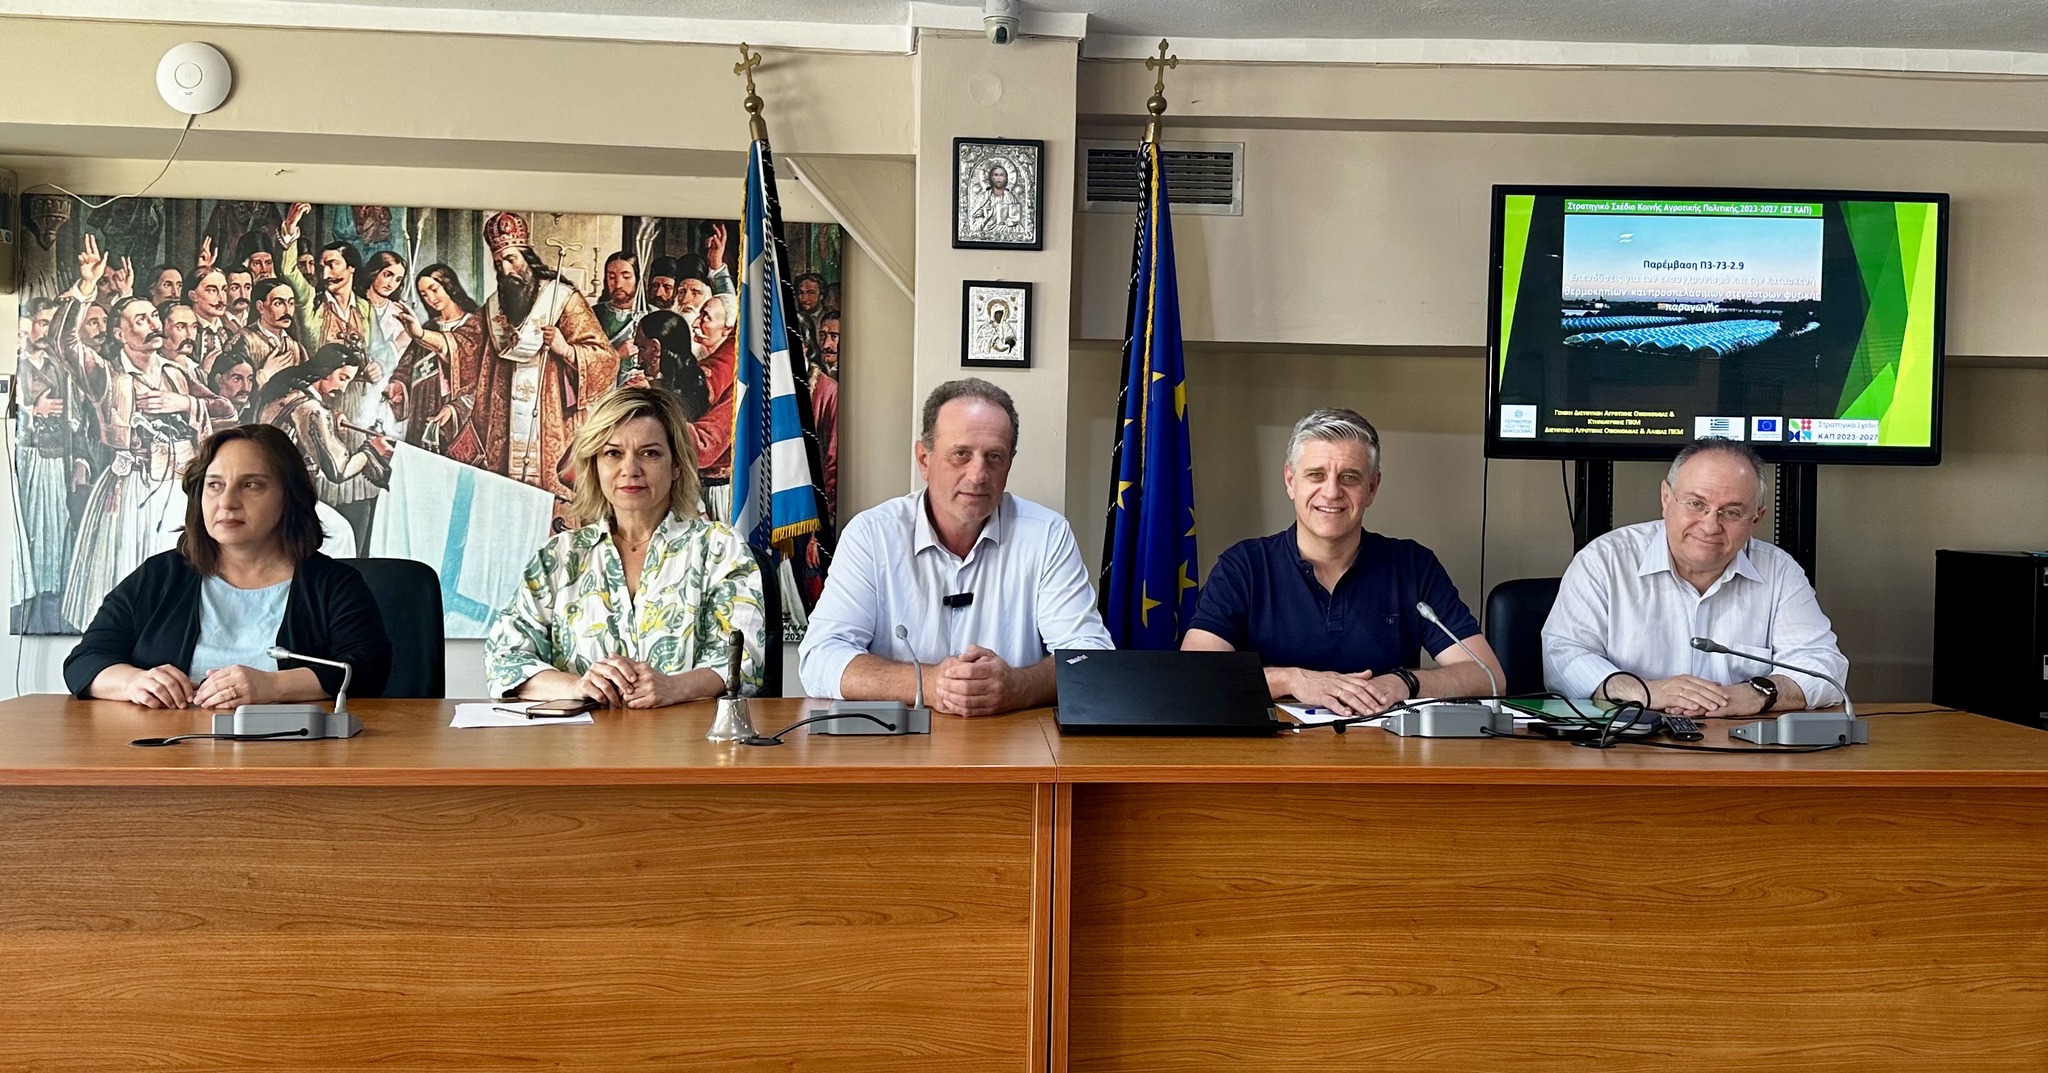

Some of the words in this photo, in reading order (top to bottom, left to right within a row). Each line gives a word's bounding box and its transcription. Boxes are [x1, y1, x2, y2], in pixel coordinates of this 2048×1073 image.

[1567, 202, 1610, 212] Στρατηγικό
[1611, 202, 1636, 212] Σχέδιο
[1637, 203, 1662, 213] Κοινής
[1663, 203, 1701, 214] Αγροτικής
[1702, 204, 1739, 214] Πολιτικής
[1740, 205, 1778, 213] 2023-2027
[1780, 206, 1793, 215] (ΣΣ
[1794, 206, 1812, 215] ΚΑΠ)
[1643, 260, 1698, 271] Παρέμβαση
[1700, 261, 1745, 271] Π3-73-2.9
[1564, 287, 1627, 297] θερμοκηπίων
[1631, 288, 1647, 297] και
[1648, 288, 1723, 299] προσπελάσιμων
[1725, 289, 1782, 300] στεγάστρων
[1784, 290, 1821, 301] φυτικής
[1665, 303, 1719, 313] παραγωγής
[785, 633, 804, 641] 2021
